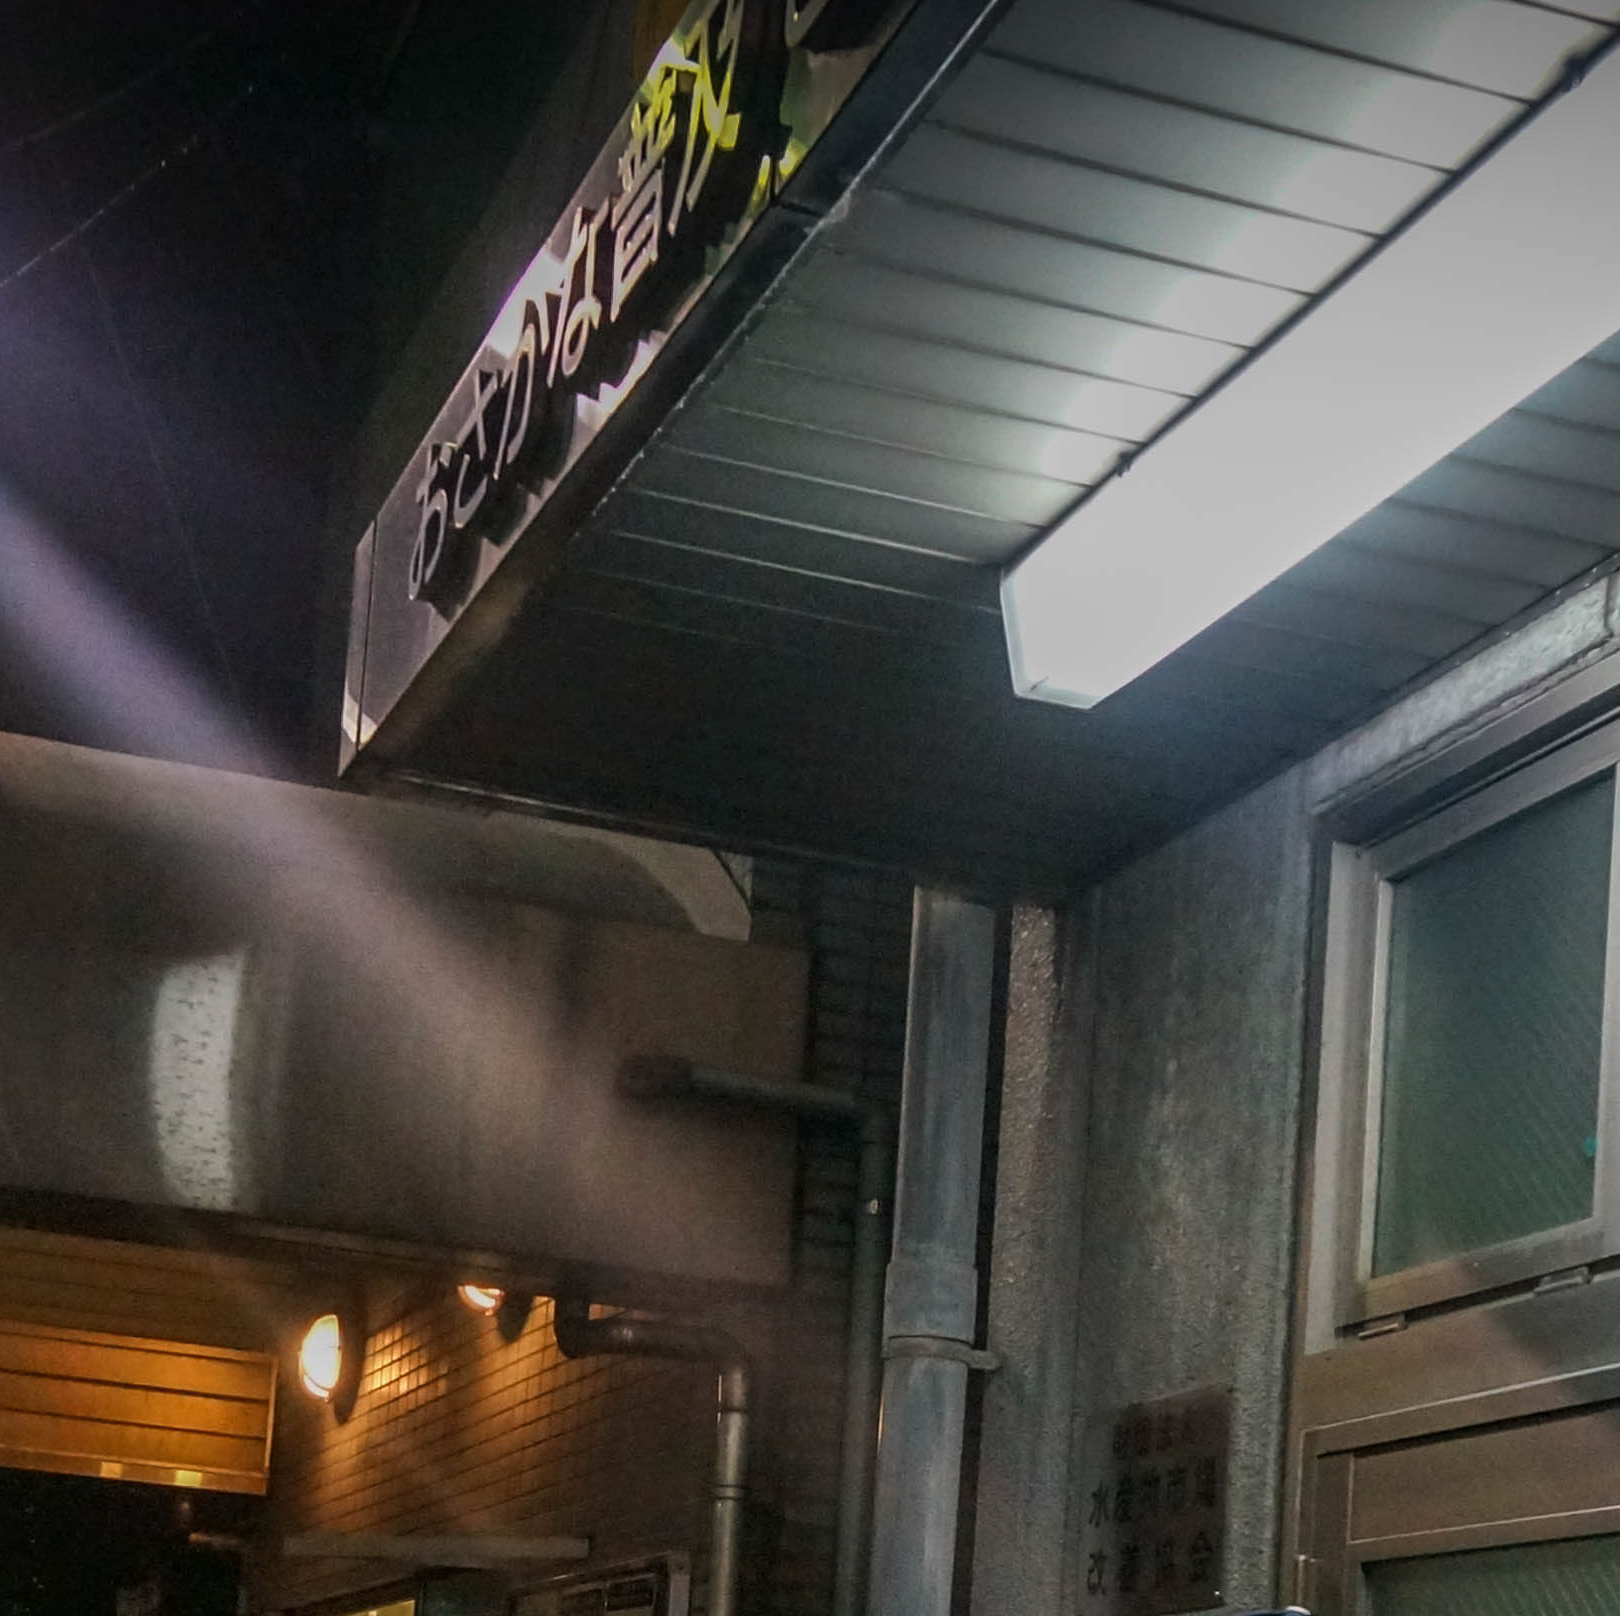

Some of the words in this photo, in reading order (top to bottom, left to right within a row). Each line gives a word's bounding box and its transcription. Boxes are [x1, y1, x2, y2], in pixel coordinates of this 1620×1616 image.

[407, 0, 832, 602] おさかな普及
